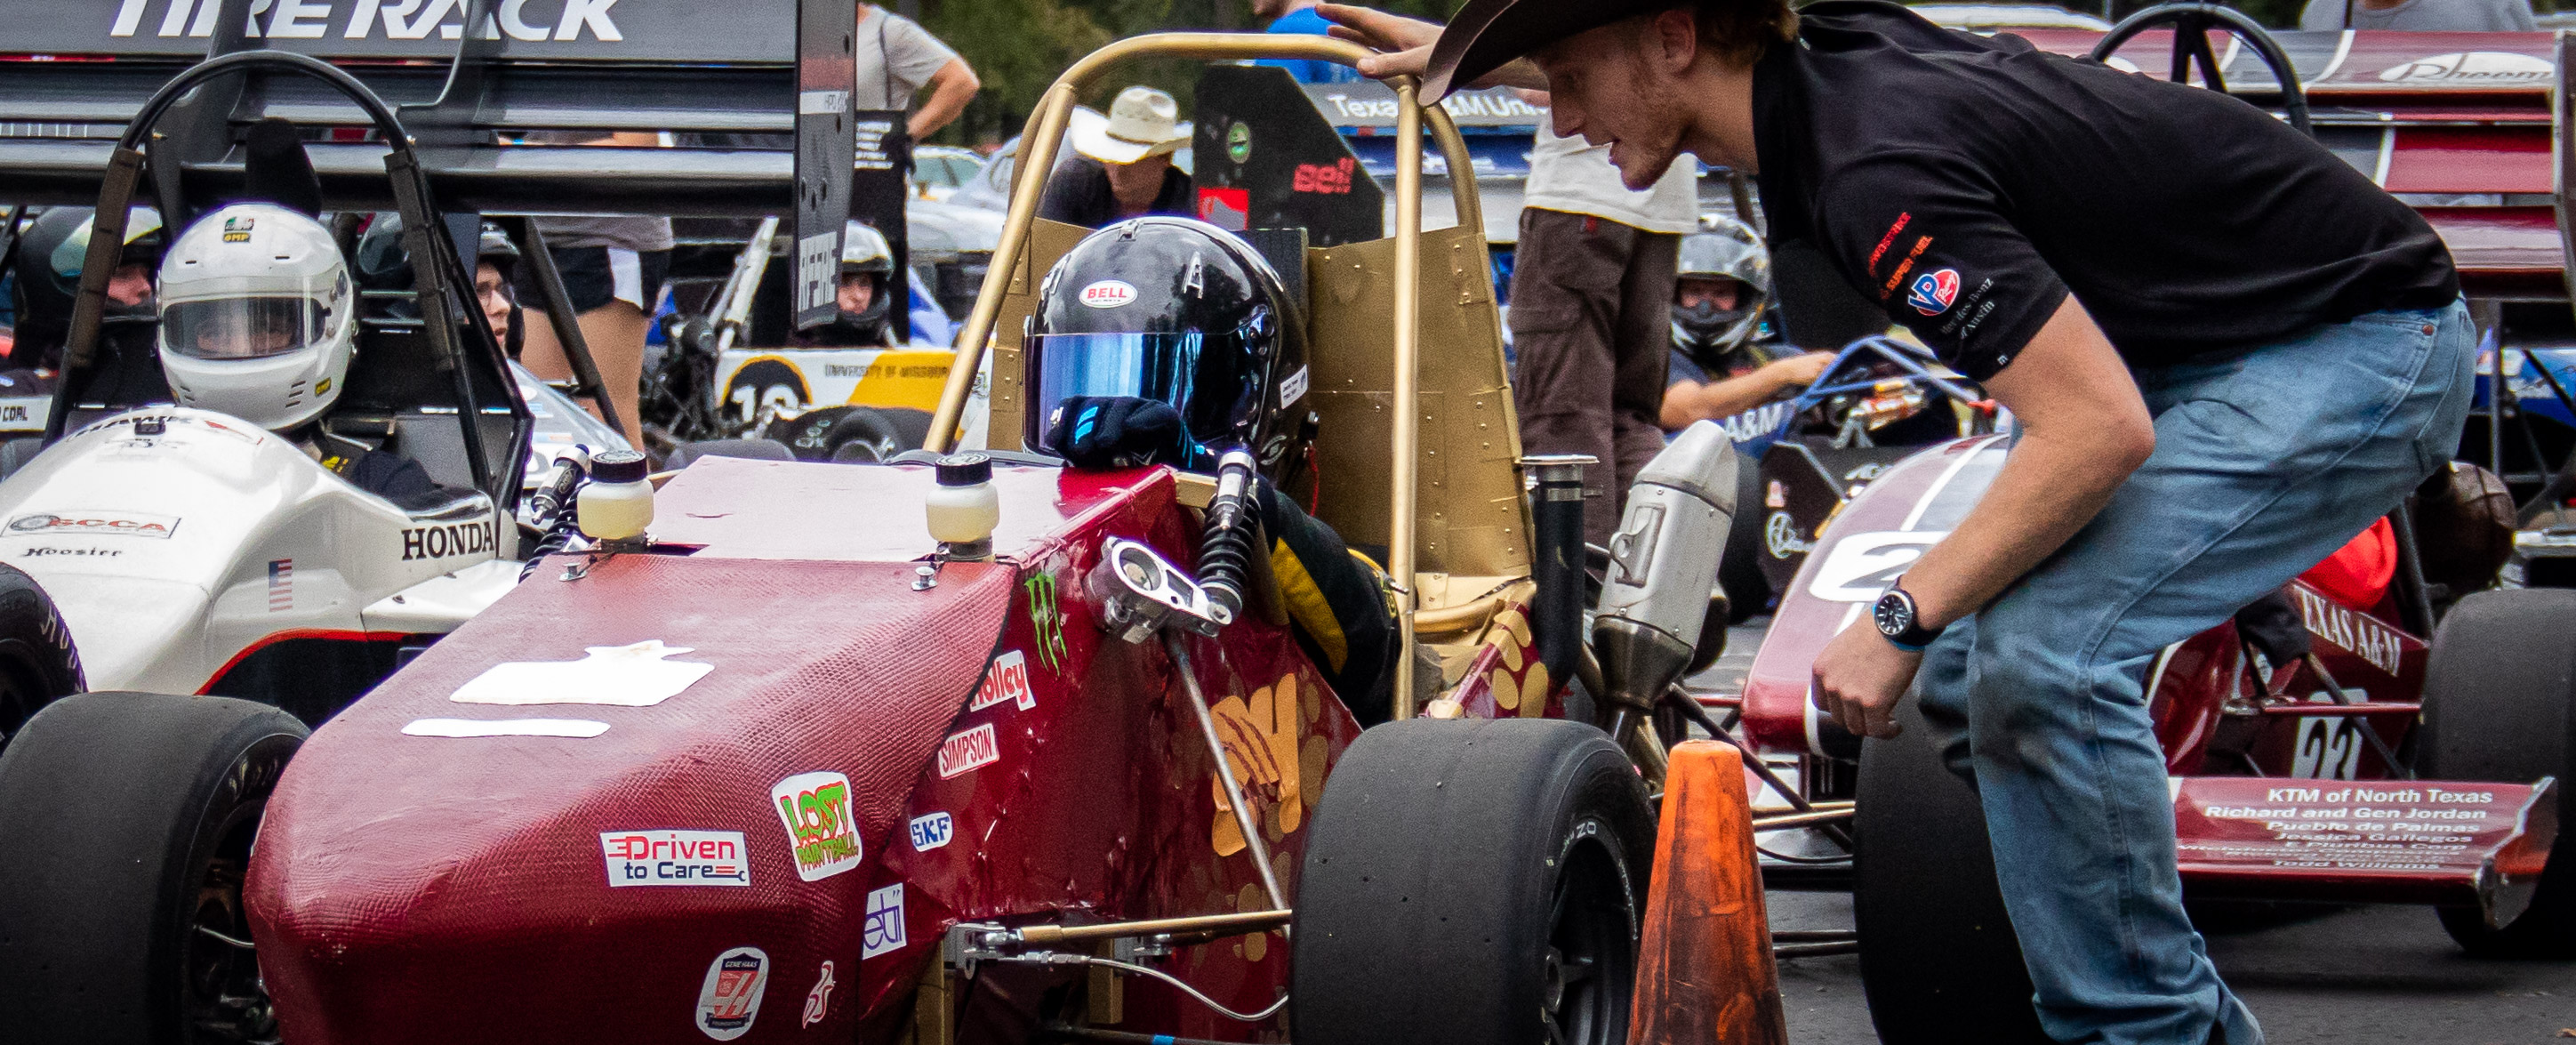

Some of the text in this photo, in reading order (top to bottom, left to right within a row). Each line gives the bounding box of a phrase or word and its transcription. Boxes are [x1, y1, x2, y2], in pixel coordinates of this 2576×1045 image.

[343, 0, 623, 41] RACK
[1328, 93, 1399, 117] Texa
[1087, 287, 1128, 300] BELL
[1725, 402, 1784, 442] A&M
[401, 521, 494, 560] HONDA
[2357, 618, 2402, 679] A&M
[942, 729, 993, 774] SIMPSON
[780, 780, 848, 843] LOST
[2267, 788, 2493, 804] KTM of North Texas
[2204, 806, 2487, 819] Richard and Gen Jordan
[2267, 821, 2480, 832] Pueblo de Palmas
[608, 834, 735, 860] Driven
[911, 816, 951, 848] SKF
[796, 831, 859, 872] PAINTBALL
[624, 862, 713, 879] to Care
